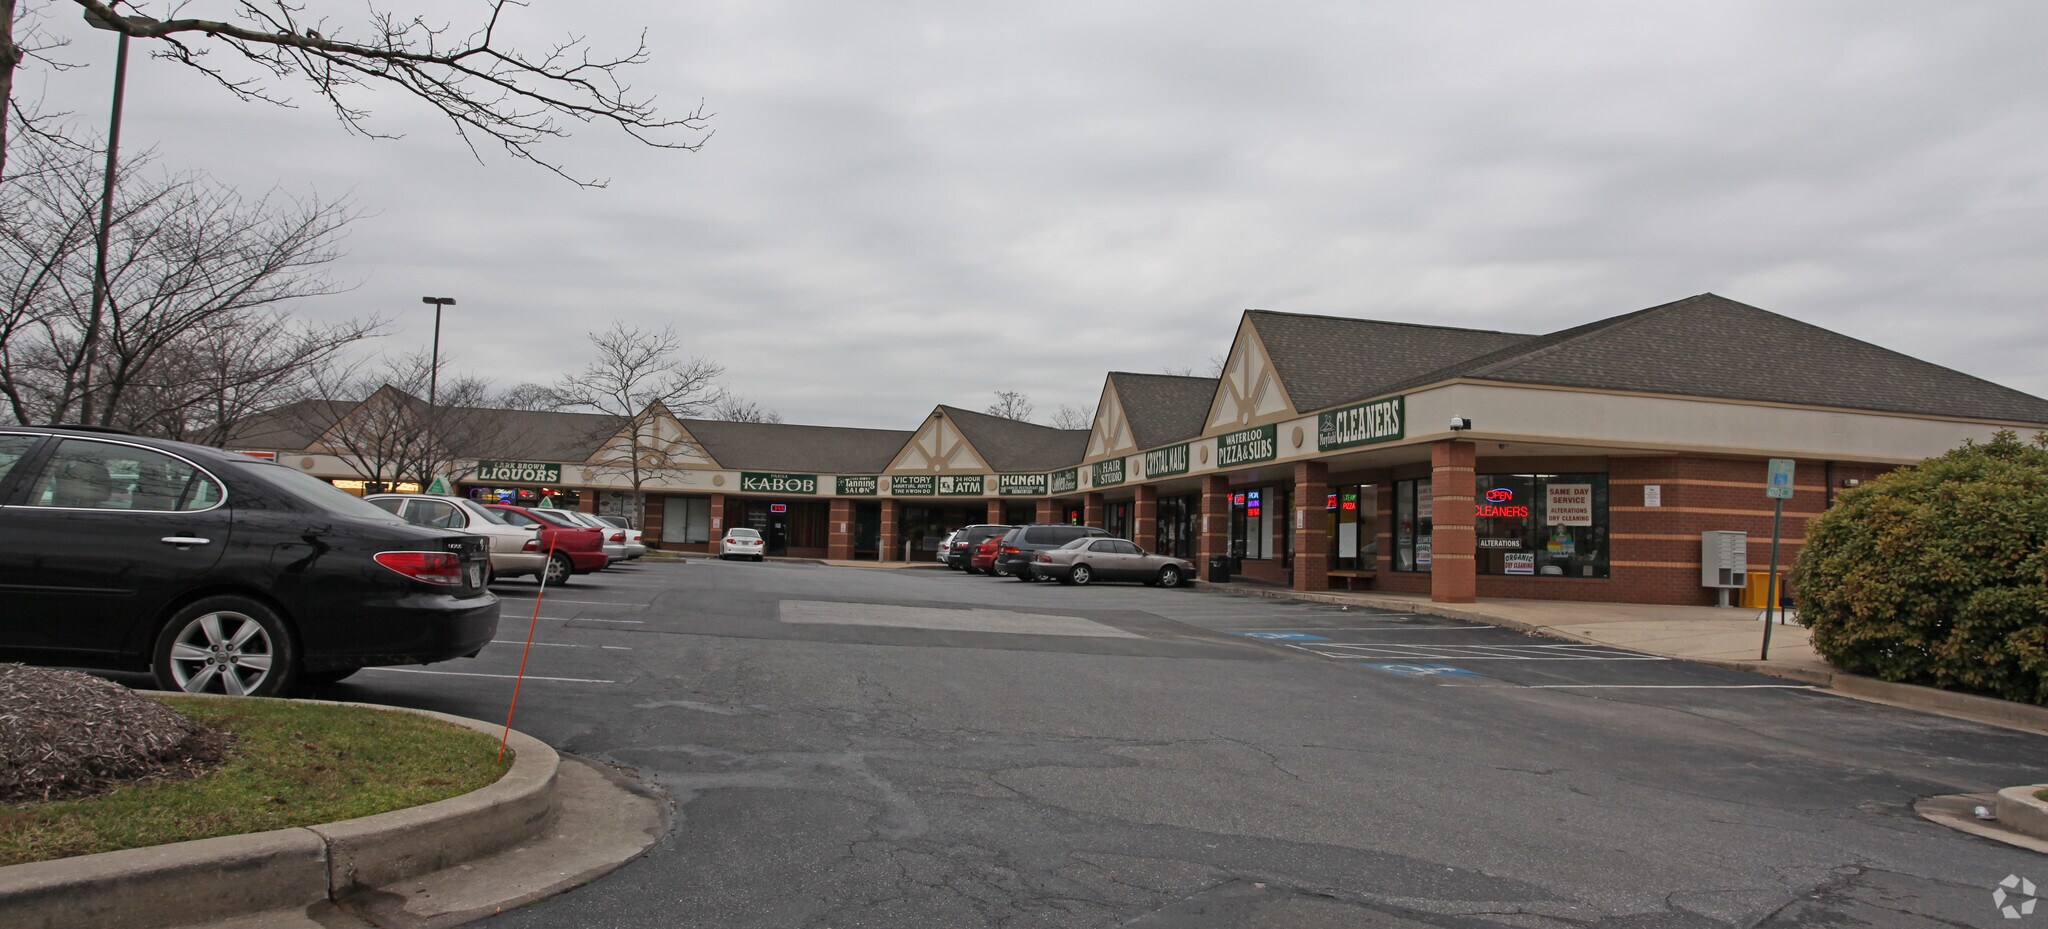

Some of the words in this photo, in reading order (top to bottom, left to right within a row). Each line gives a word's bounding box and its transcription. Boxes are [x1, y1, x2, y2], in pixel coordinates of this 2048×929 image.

[1336, 400, 1399, 444] CLEANERS
[1226, 429, 1262, 445] WATERLOO
[1102, 460, 1120, 474] HAIR
[1146, 450, 1168, 476] CRYSTAL
[1169, 445, 1186, 472] NAILS
[480, 467, 558, 482] LIQUORS
[1001, 474, 1045, 486] HUNAN
[1101, 471, 1122, 484] STUDIO
[744, 477, 814, 492] KABOB
[845, 478, 875, 490] Tanning
[955, 482, 981, 493] ATM
[1485, 490, 1513, 500] OPEN
[1342, 502, 1356, 510] PIZZA
[1505, 554, 1533, 562] ORGANIC
